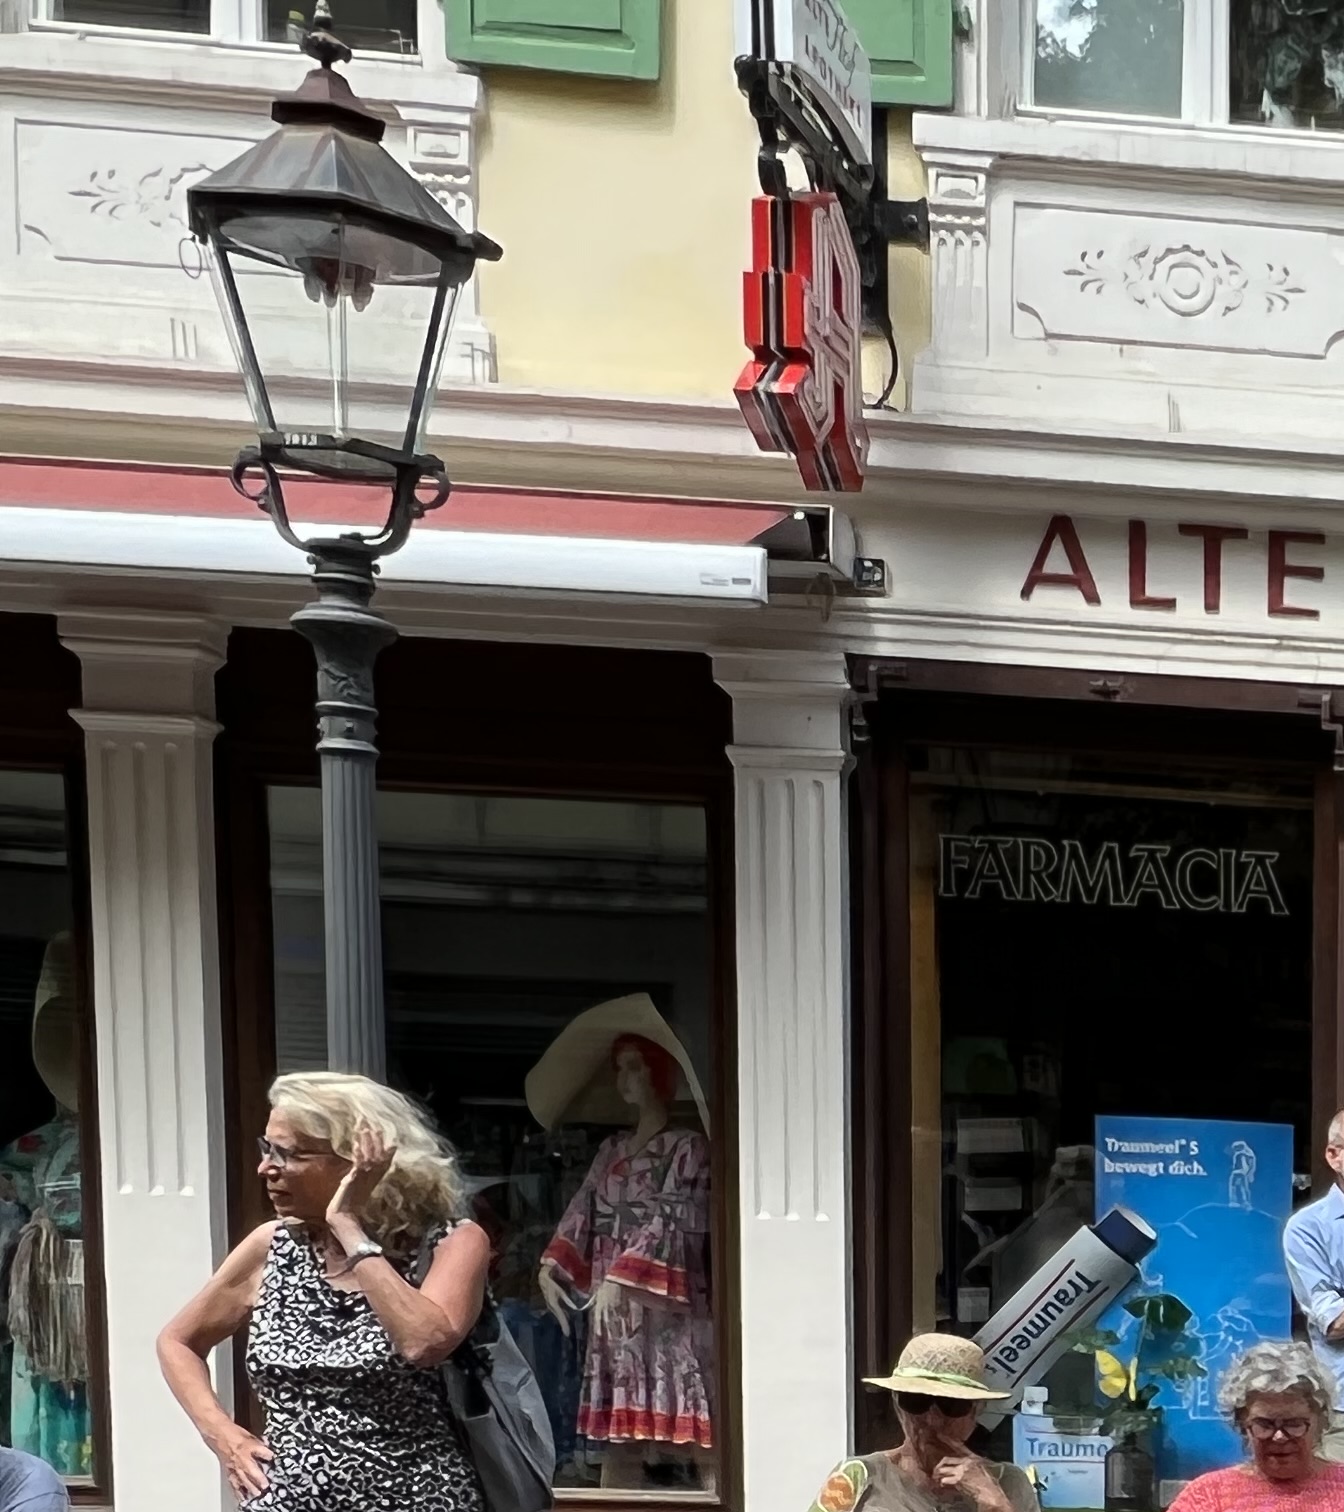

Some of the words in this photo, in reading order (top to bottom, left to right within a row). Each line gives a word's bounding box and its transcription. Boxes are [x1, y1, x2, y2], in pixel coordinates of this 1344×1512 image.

[1020, 514, 1326, 621] ALTE
[938, 833, 1290, 915] FARMACIA
[1104, 1158, 1164, 1177] bewegt
